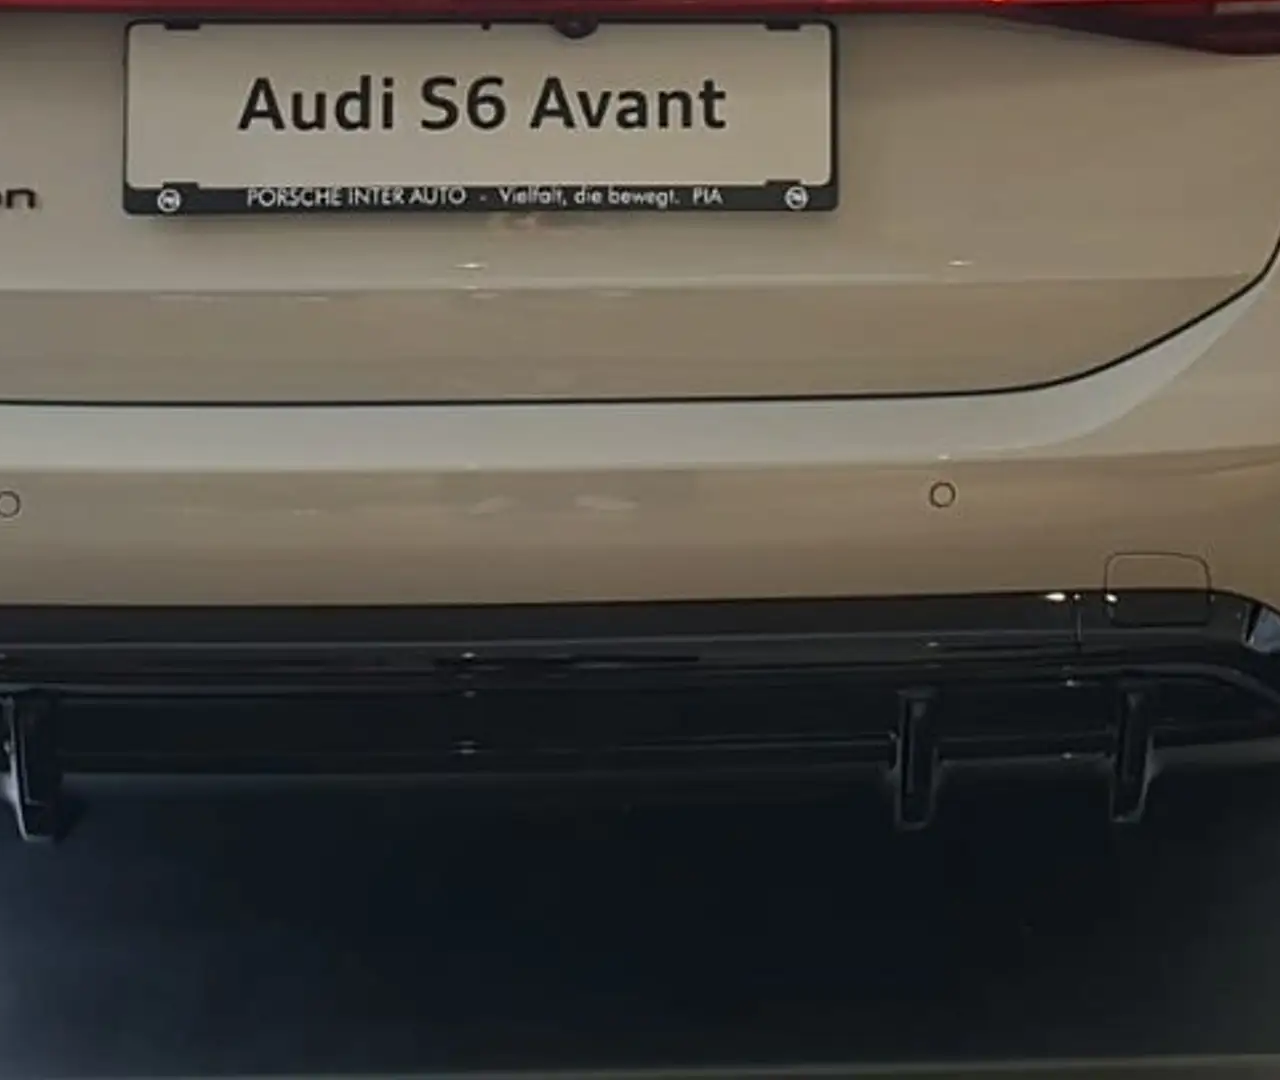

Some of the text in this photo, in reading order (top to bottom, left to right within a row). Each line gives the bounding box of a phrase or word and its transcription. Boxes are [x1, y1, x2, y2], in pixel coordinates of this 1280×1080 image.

[237, 74, 728, 131] Audi S6 Avant
[246, 186, 343, 208] PORSCHE
[347, 186, 404, 206] INTER
[408, 185, 468, 206] AUTO
[497, 185, 568, 207] Vielfalt,
[573, 185, 603, 205] die
[607, 185, 681, 209] bewegt.
[692, 185, 723, 205] PIA
